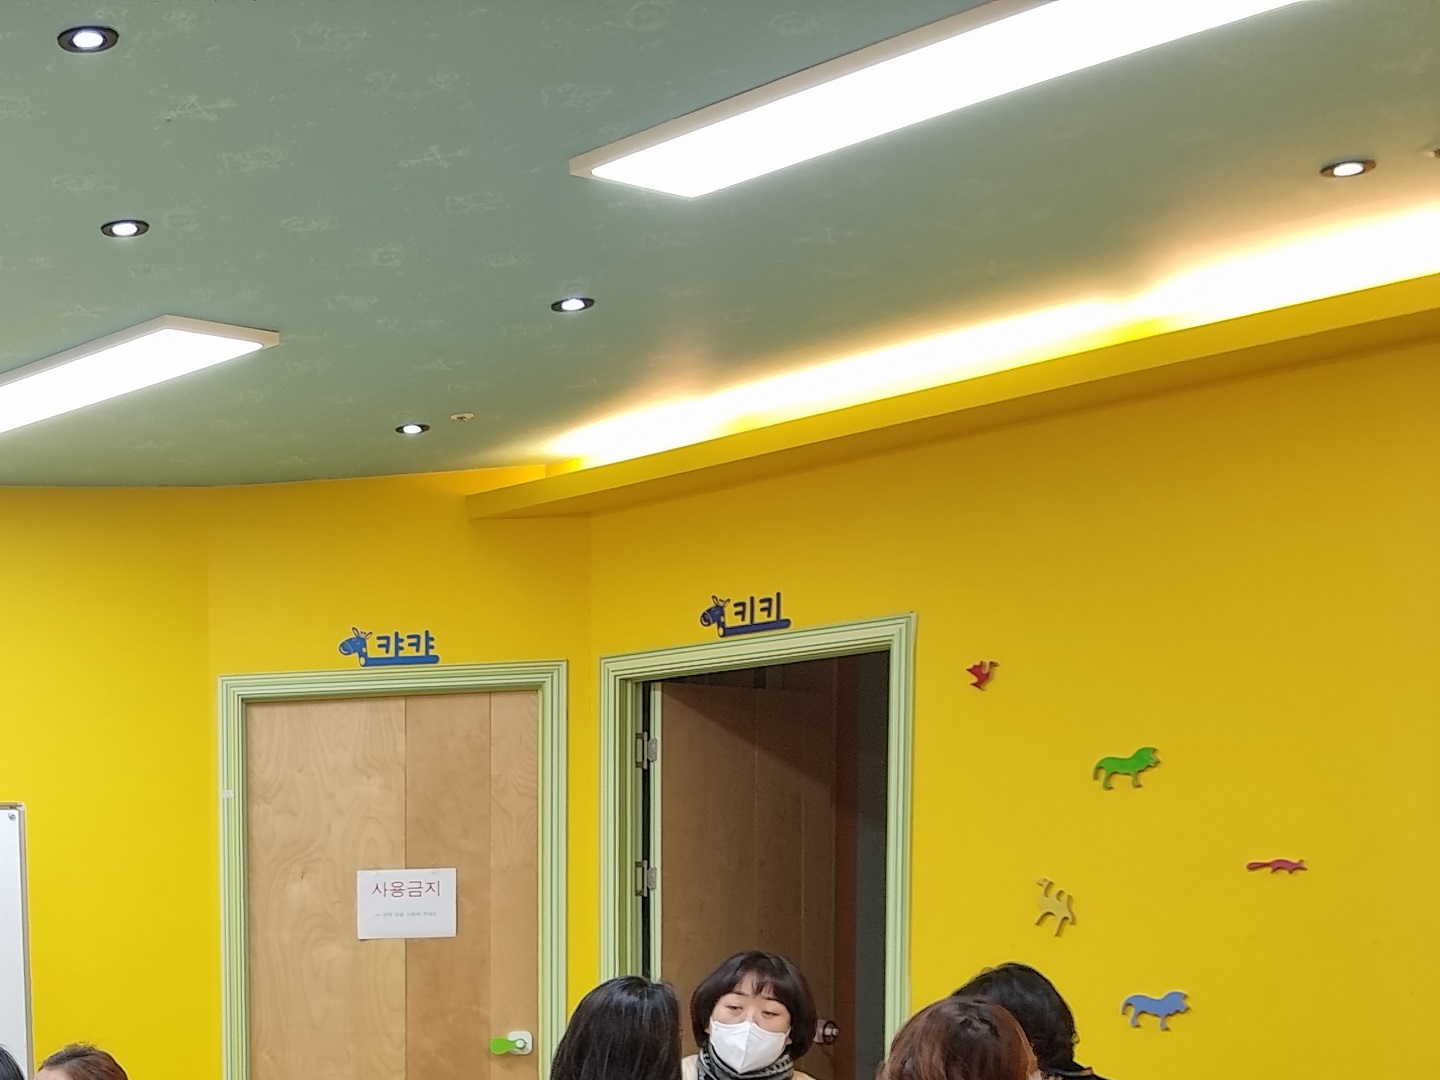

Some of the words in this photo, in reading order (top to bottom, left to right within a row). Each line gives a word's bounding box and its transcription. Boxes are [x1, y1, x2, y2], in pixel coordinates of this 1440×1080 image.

[732, 591, 783, 624] 키키
[375, 629, 435, 658] 캬캬
[371, 880, 441, 898] 사용금지
